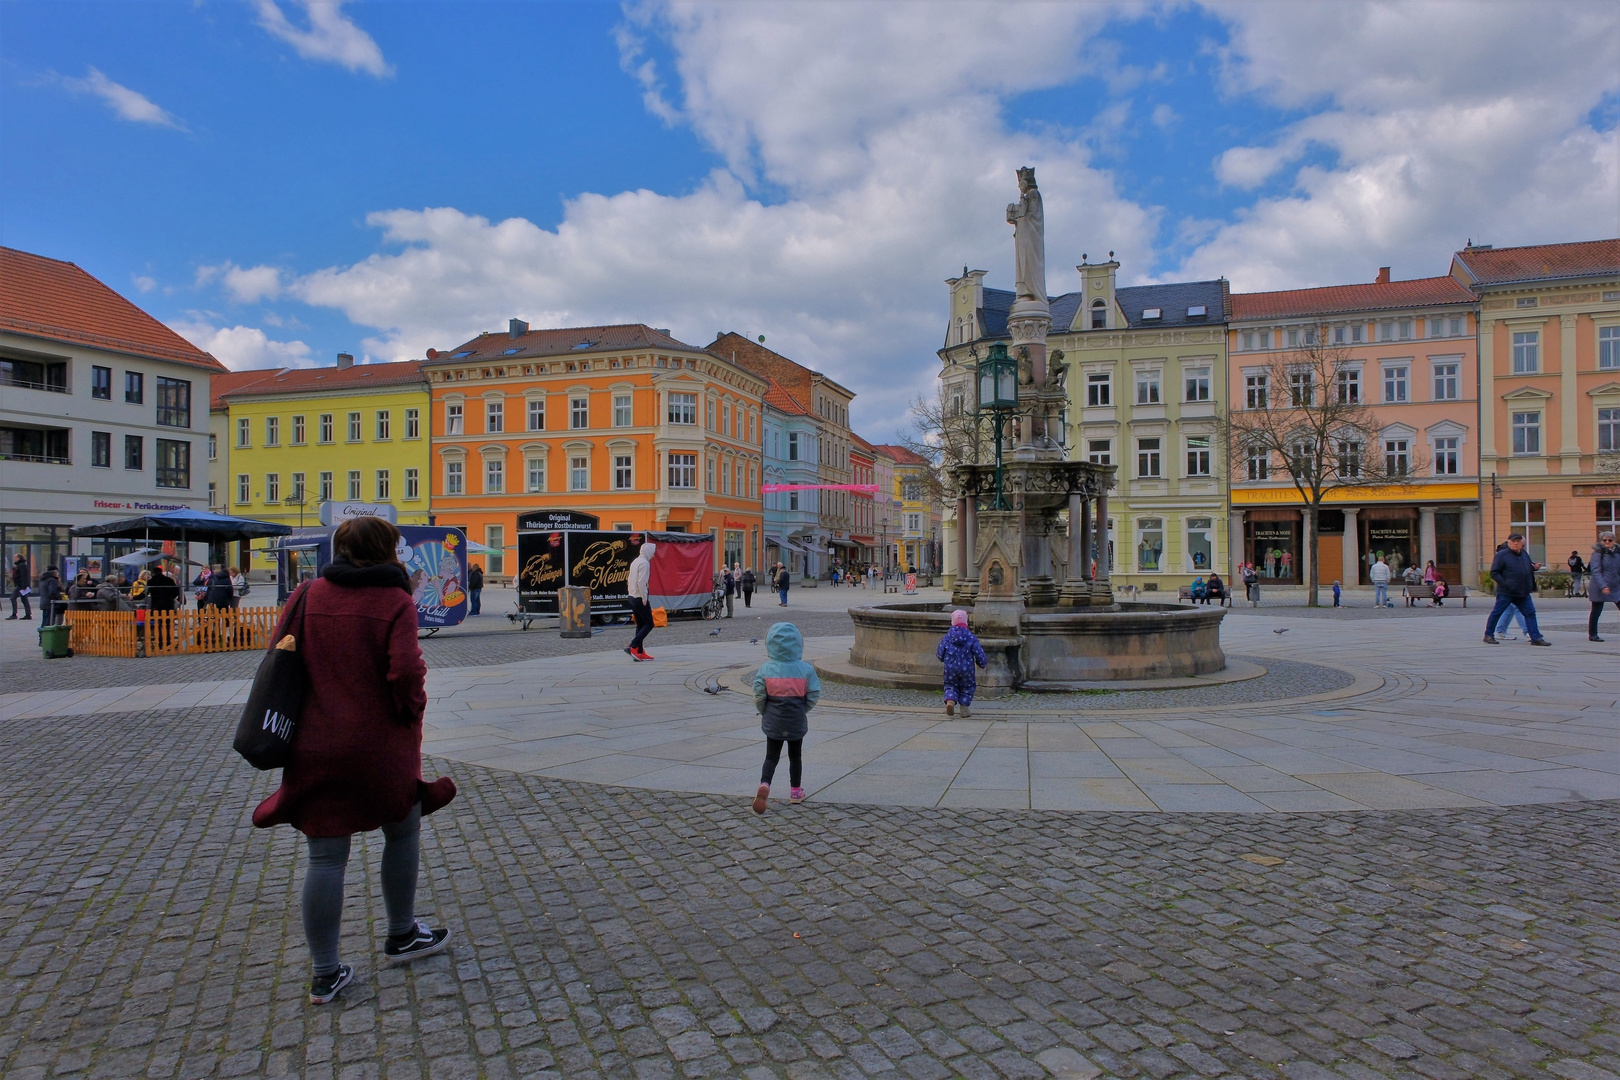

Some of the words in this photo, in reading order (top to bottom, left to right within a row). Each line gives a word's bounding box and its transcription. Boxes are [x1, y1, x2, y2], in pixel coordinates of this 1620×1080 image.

[1246, 491, 1297, 500] TRACHTEN
[94, 500, 125, 509] Friseur-
[343, 505, 378, 518] Original
[548, 514, 571, 523] Original
[526, 521, 553, 530] Thüringer
[590, 564, 630, 590] Meinin
[426, 604, 450, 617] Chill
